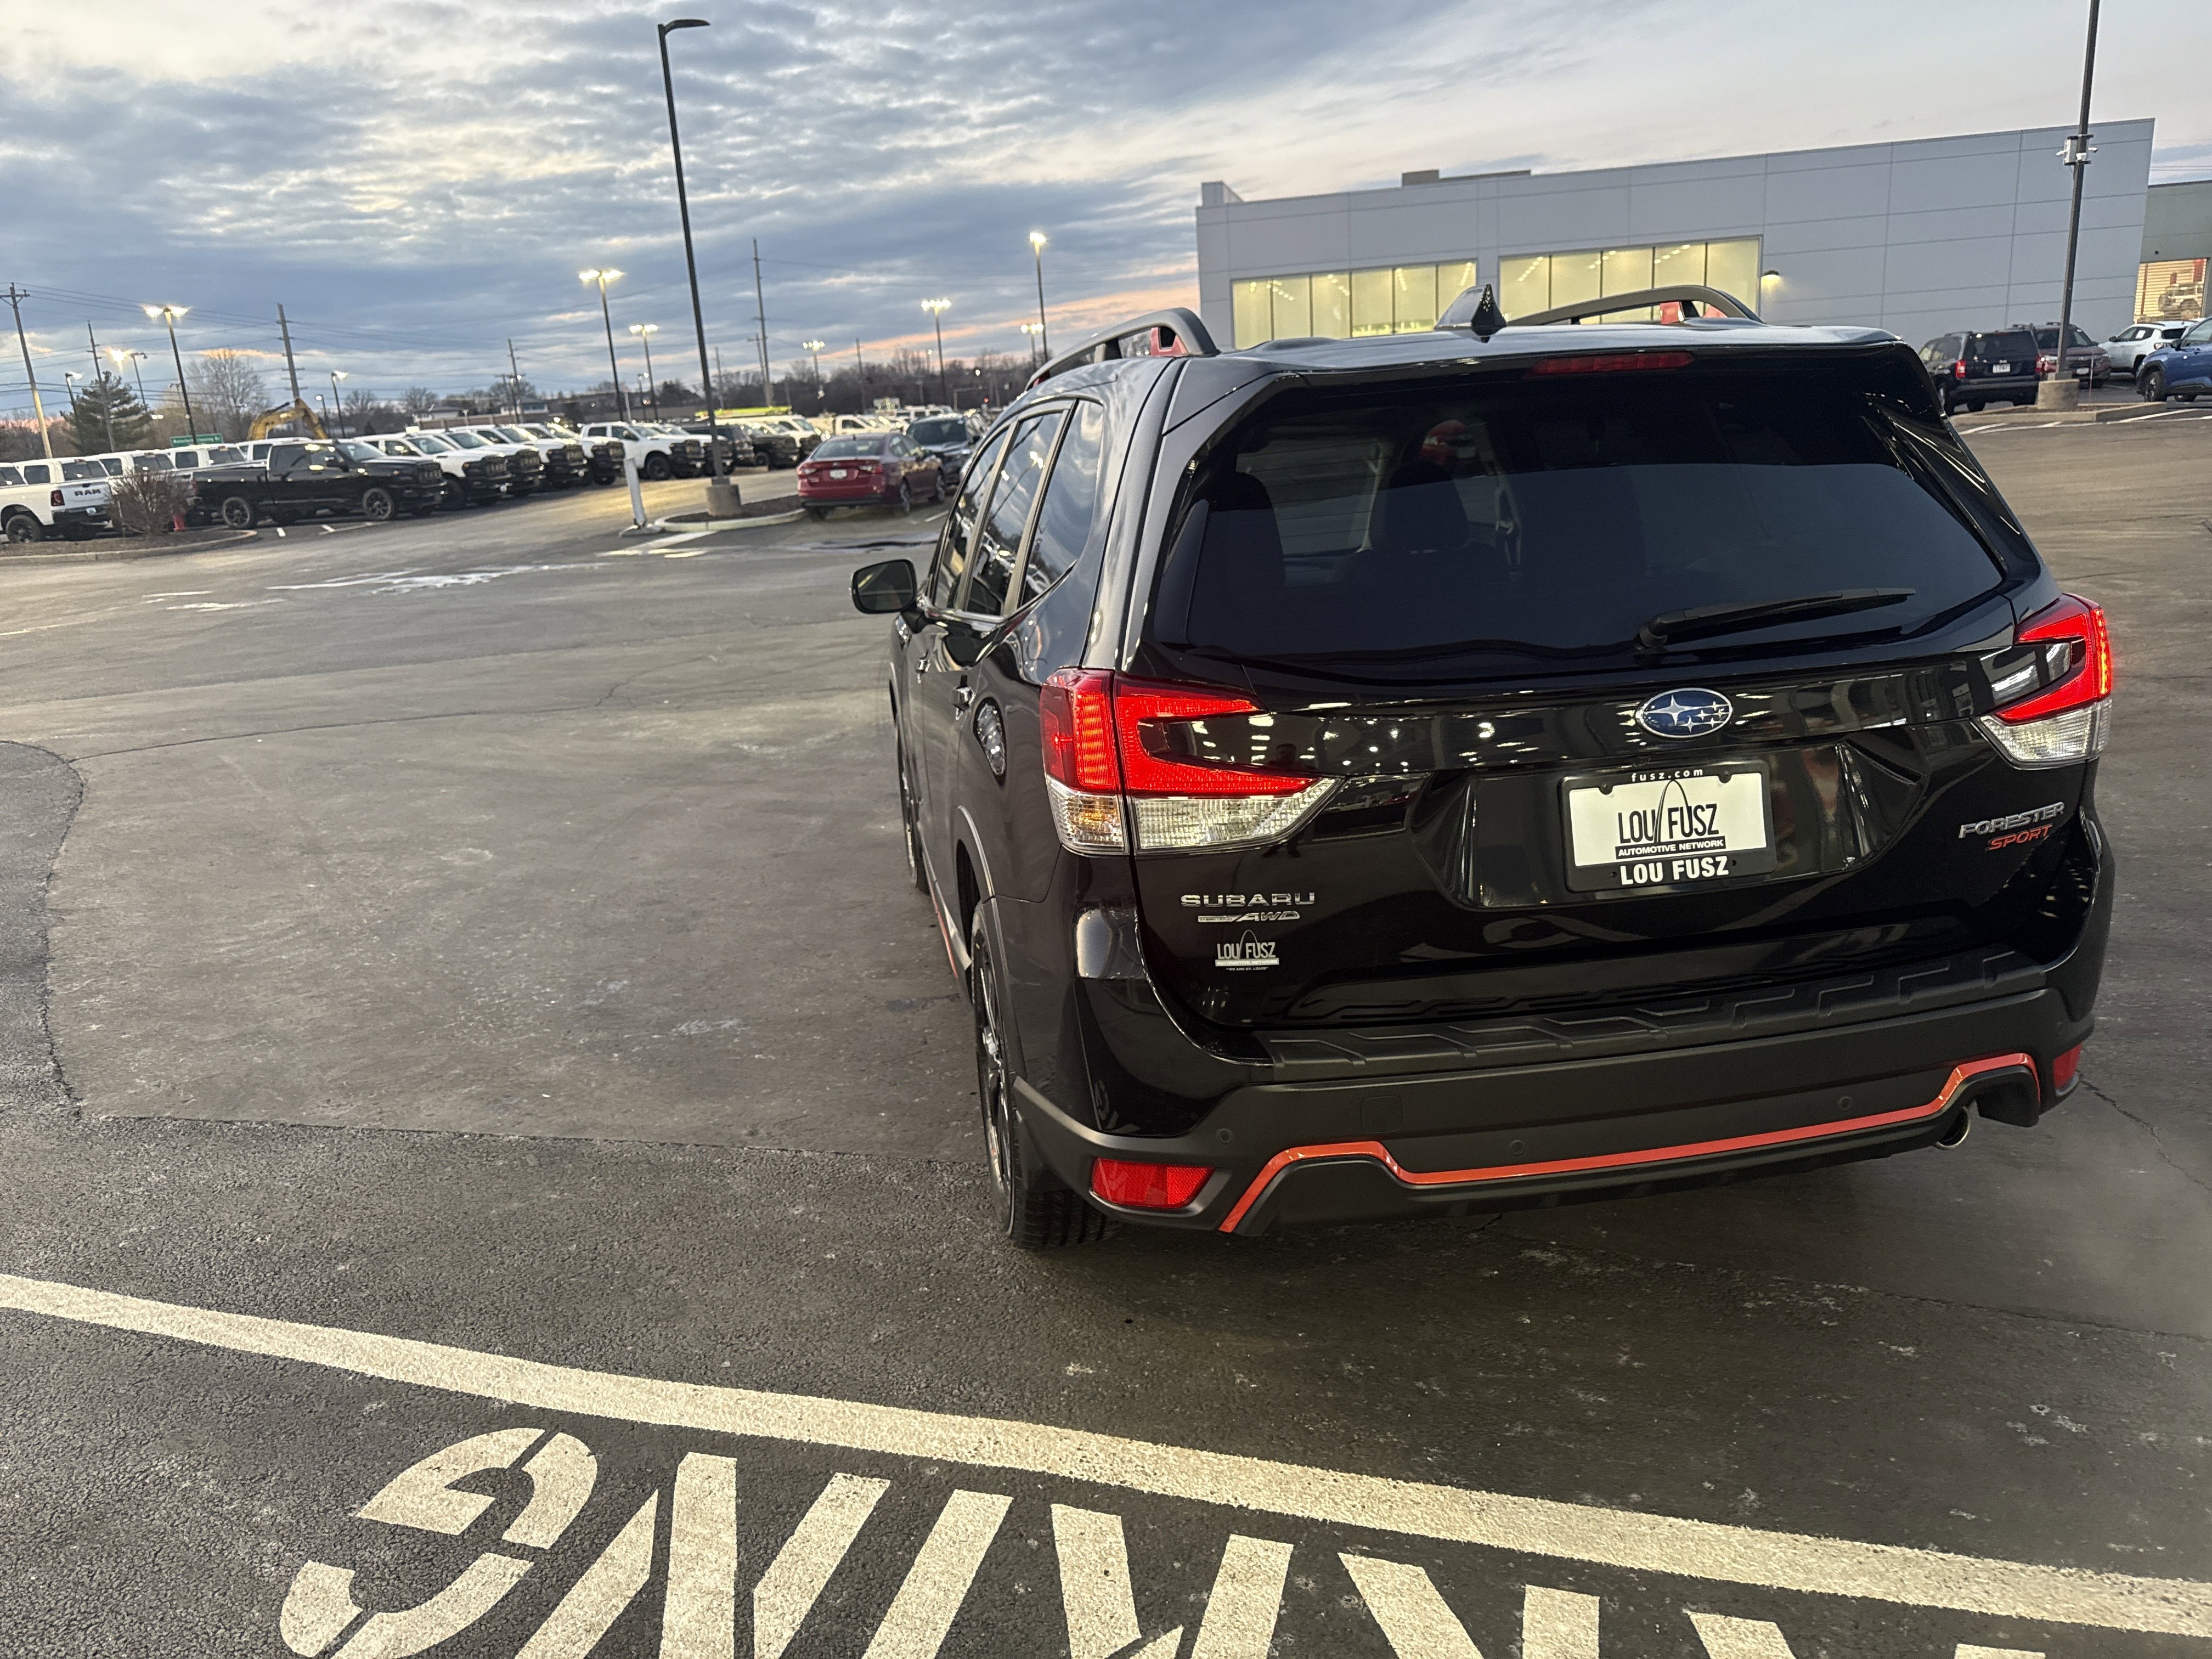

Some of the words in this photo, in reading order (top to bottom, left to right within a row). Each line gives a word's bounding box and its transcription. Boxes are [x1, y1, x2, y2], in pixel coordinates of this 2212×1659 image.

[74, 488, 101, 496] RAM
[1631, 768, 1703, 782] fusz.com
[1618, 809, 1656, 844] LOU
[1668, 803, 1719, 839] FUSZ
[1958, 802, 2064, 838] FORESTER
[1987, 824, 2053, 850] SPORT
[1618, 844, 1676, 856] AUTOMOTIVE
[1679, 839, 1724, 850] NETWORK
[1620, 862, 1663, 885] LOU
[1672, 856, 1729, 881] FUSZ
[1181, 892, 1315, 907] SUBARU
[1235, 911, 1300, 922] AWD
[1217, 943, 1239, 960] LOU
[1245, 941, 1276, 959] FUSZ
